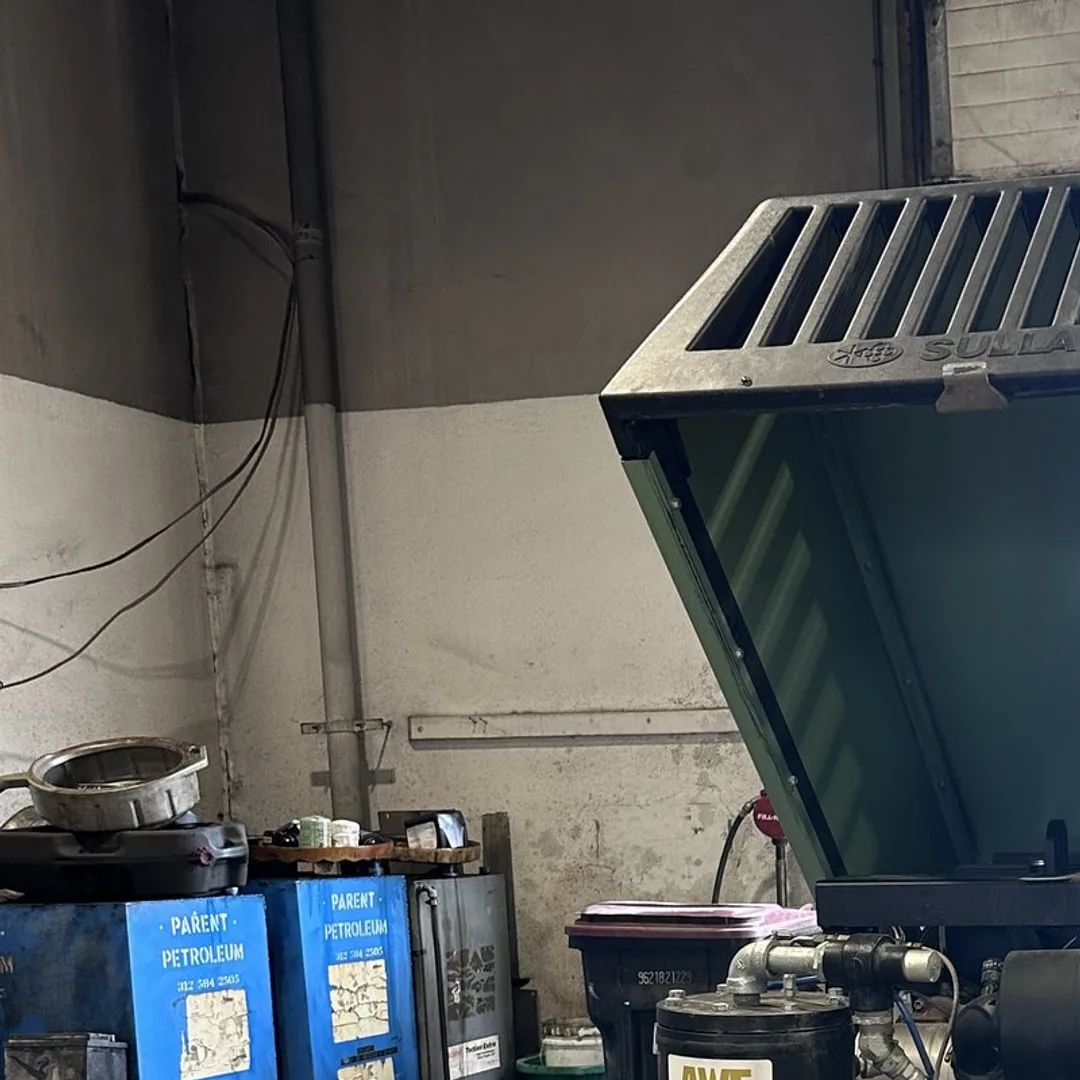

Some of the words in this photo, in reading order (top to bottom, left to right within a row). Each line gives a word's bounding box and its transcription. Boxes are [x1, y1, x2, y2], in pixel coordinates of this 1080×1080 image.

[331, 891, 375, 911] PARENT
[171, 911, 228, 936] PARENT
[324, 918, 388, 941] PETROLEUM
[162, 943, 245, 969] PETROLEUM
